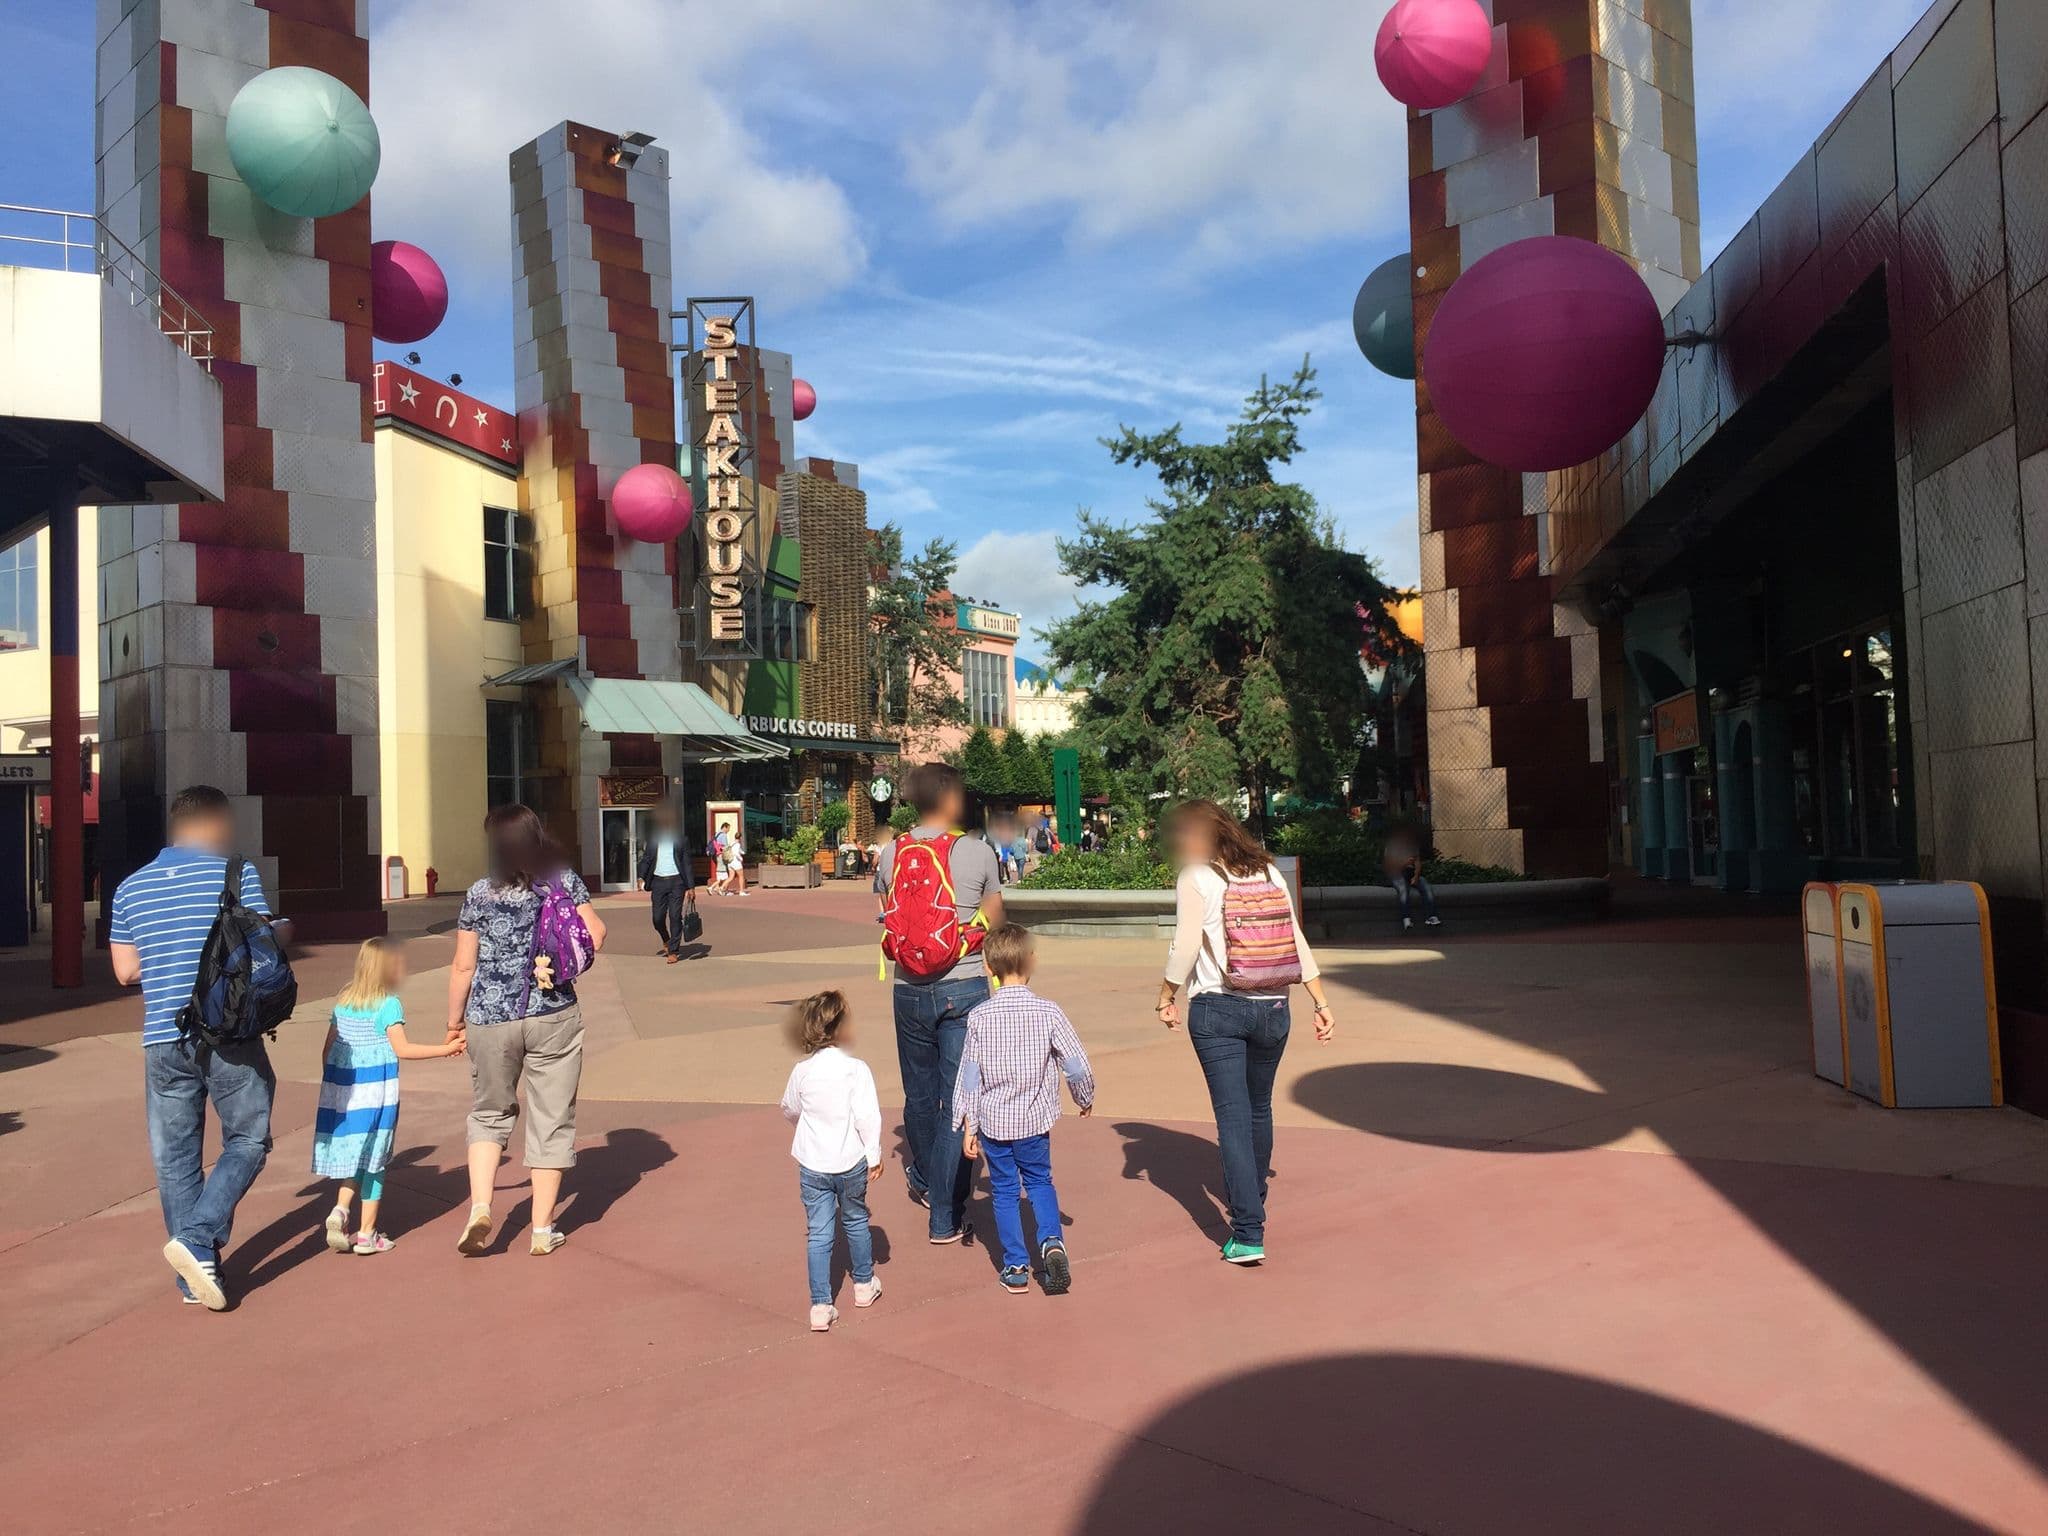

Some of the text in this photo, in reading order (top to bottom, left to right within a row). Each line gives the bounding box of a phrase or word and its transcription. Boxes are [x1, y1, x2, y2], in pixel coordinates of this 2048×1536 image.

[703, 317, 743, 640] STEAKHOUSE
[738, 714, 857, 739] ARBUCKS COFFEE
